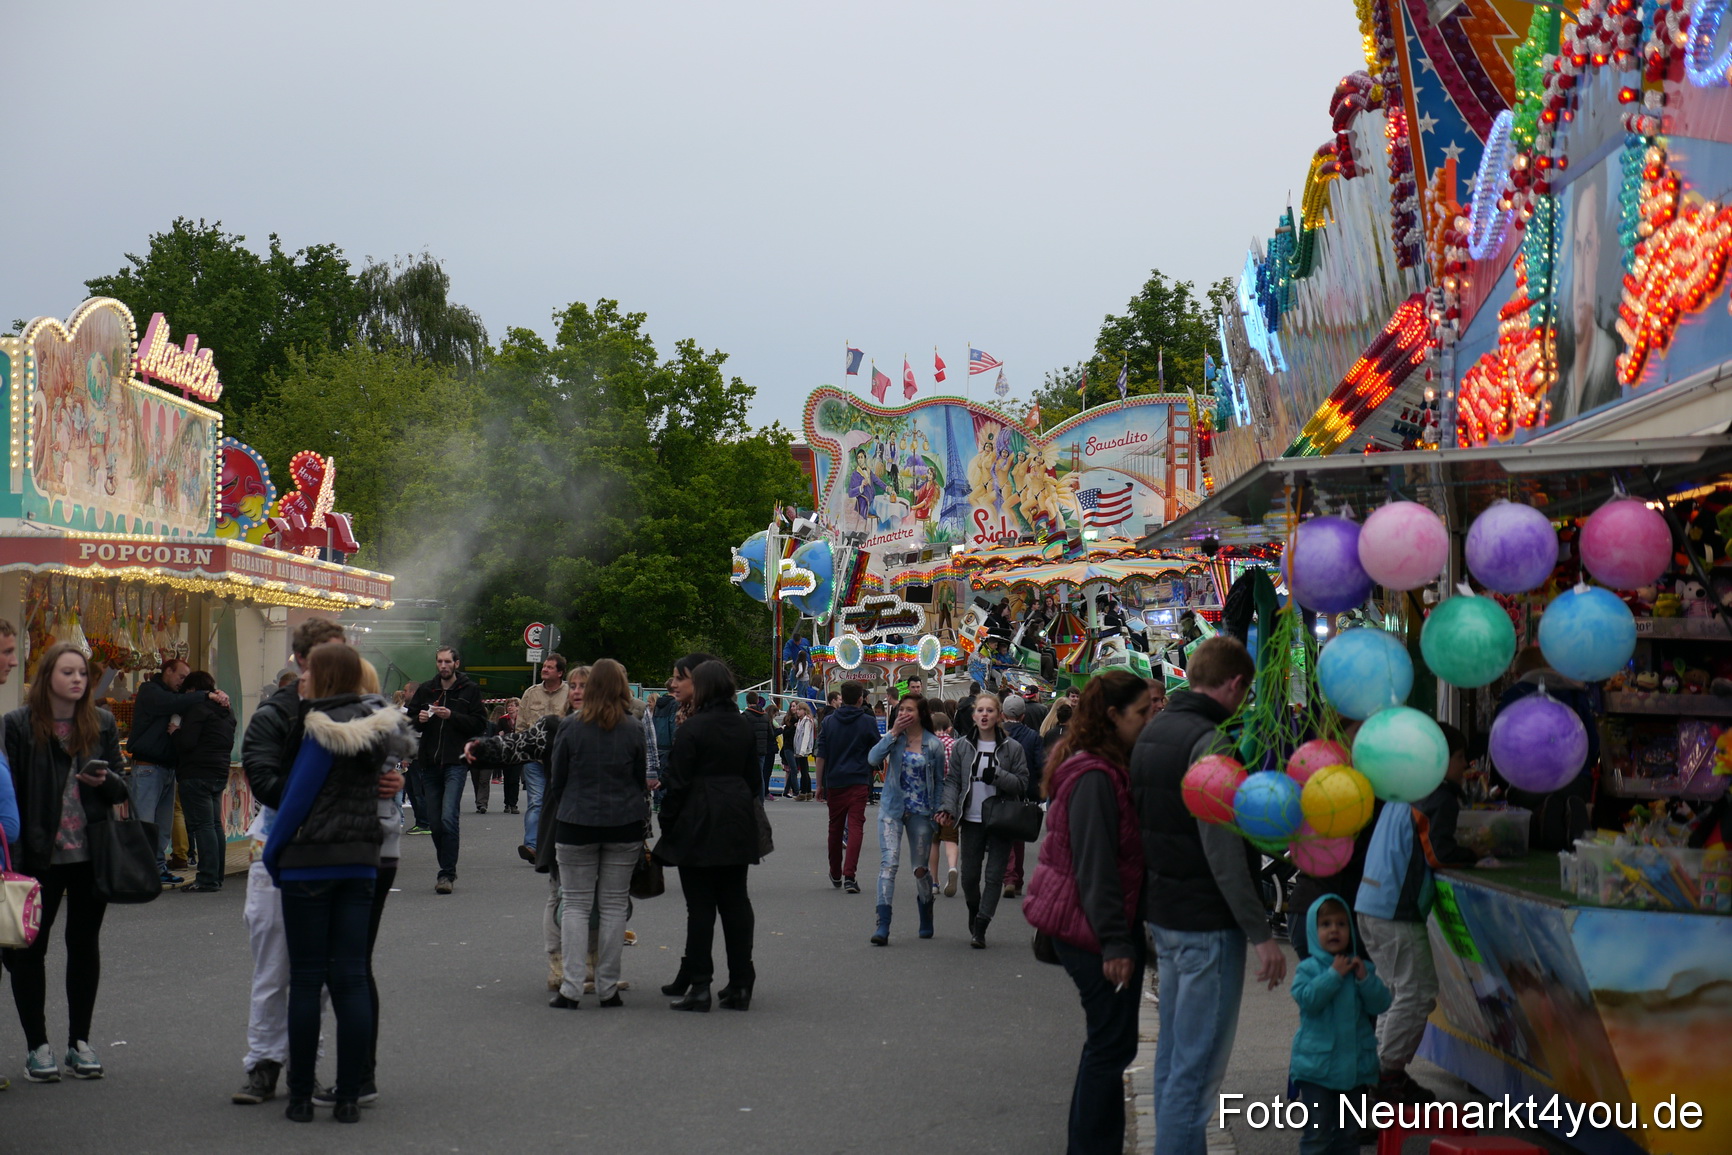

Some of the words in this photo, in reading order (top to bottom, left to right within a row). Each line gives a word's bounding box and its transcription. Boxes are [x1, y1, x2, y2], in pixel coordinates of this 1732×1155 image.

[138, 313, 223, 401] Mandeln
[1085, 430, 1148, 456] Sausalito
[857, 528, 914, 550] ontmartre
[973, 508, 1018, 545] Lido
[79, 543, 213, 565] POPCORN
[231, 552, 273, 575] GEBRANNTE
[276, 562, 306, 582] MANDELN
